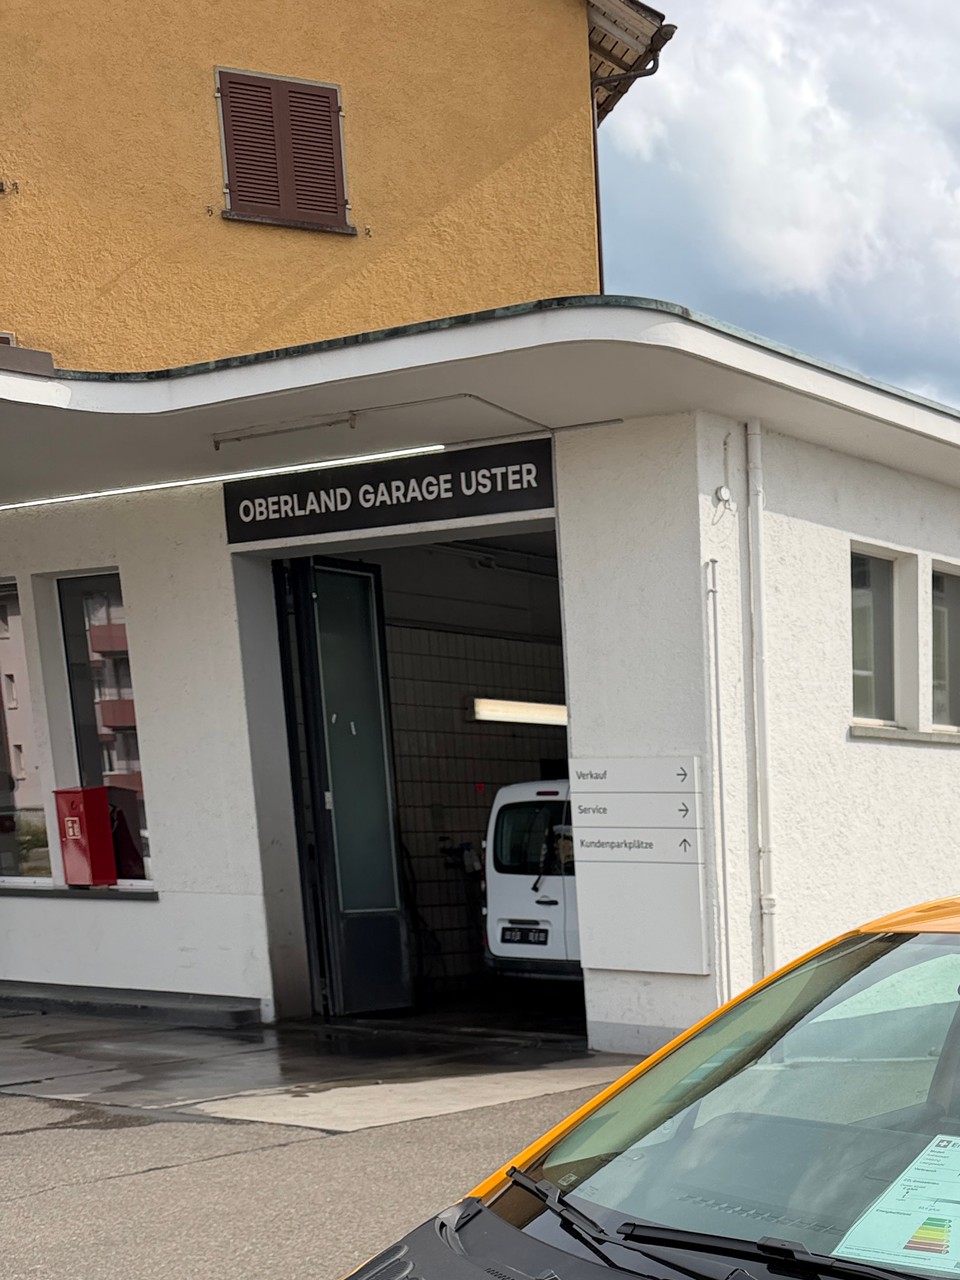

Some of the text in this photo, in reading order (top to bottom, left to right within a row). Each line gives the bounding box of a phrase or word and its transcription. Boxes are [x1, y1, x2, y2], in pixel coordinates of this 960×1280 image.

[238, 463, 538, 523] OBERLAND GARAGE USTER
[575, 770, 608, 781] Verkauf
[577, 805, 608, 815] Service
[580, 839, 654, 851] Kundenparkplätze
